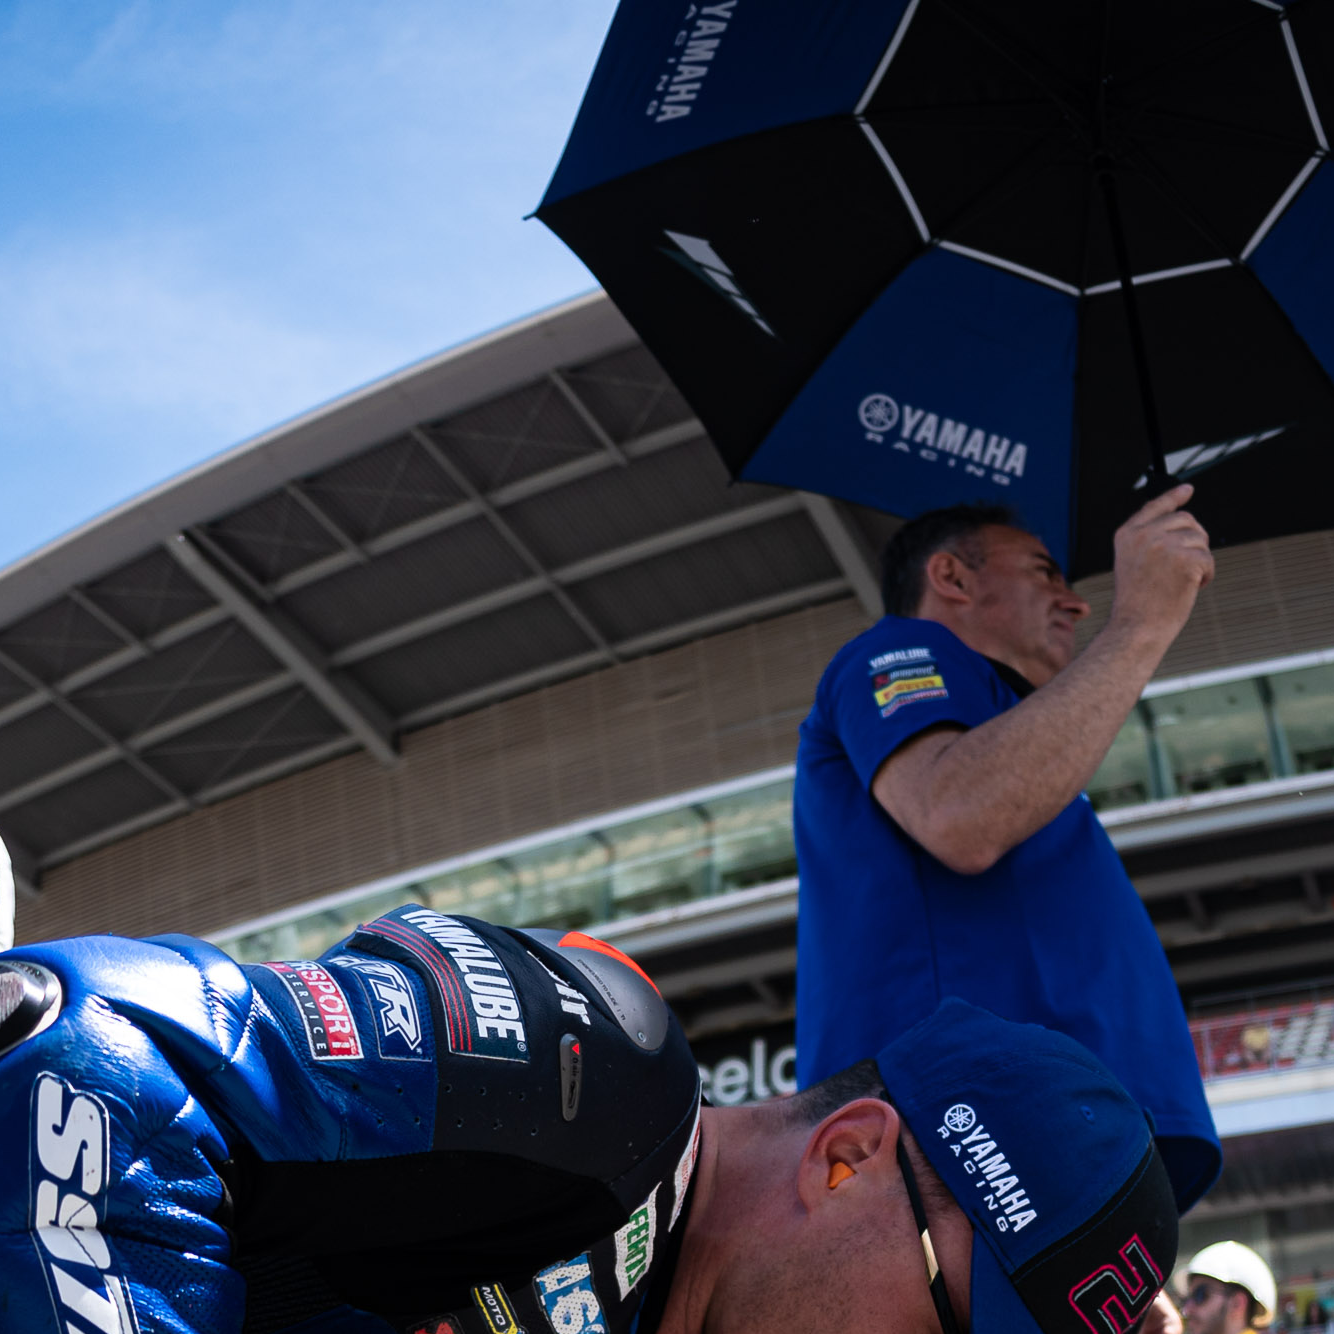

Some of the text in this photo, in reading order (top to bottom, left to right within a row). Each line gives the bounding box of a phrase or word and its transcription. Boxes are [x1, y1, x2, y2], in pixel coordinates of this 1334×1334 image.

[646, 3, 697, 116] ACING
[655, 0, 738, 122] YAMAHA
[865, 430, 1012, 486] RACING
[899, 404, 1028, 478] YAMAHA
[286, 973, 327, 1050] SERVICE
[400, 908, 525, 1042] YAMALUBE
[936, 1124, 1010, 1233] RACING
[961, 1124, 1038, 1232] YAMAHA
[482, 1286, 507, 1326] MOTO
